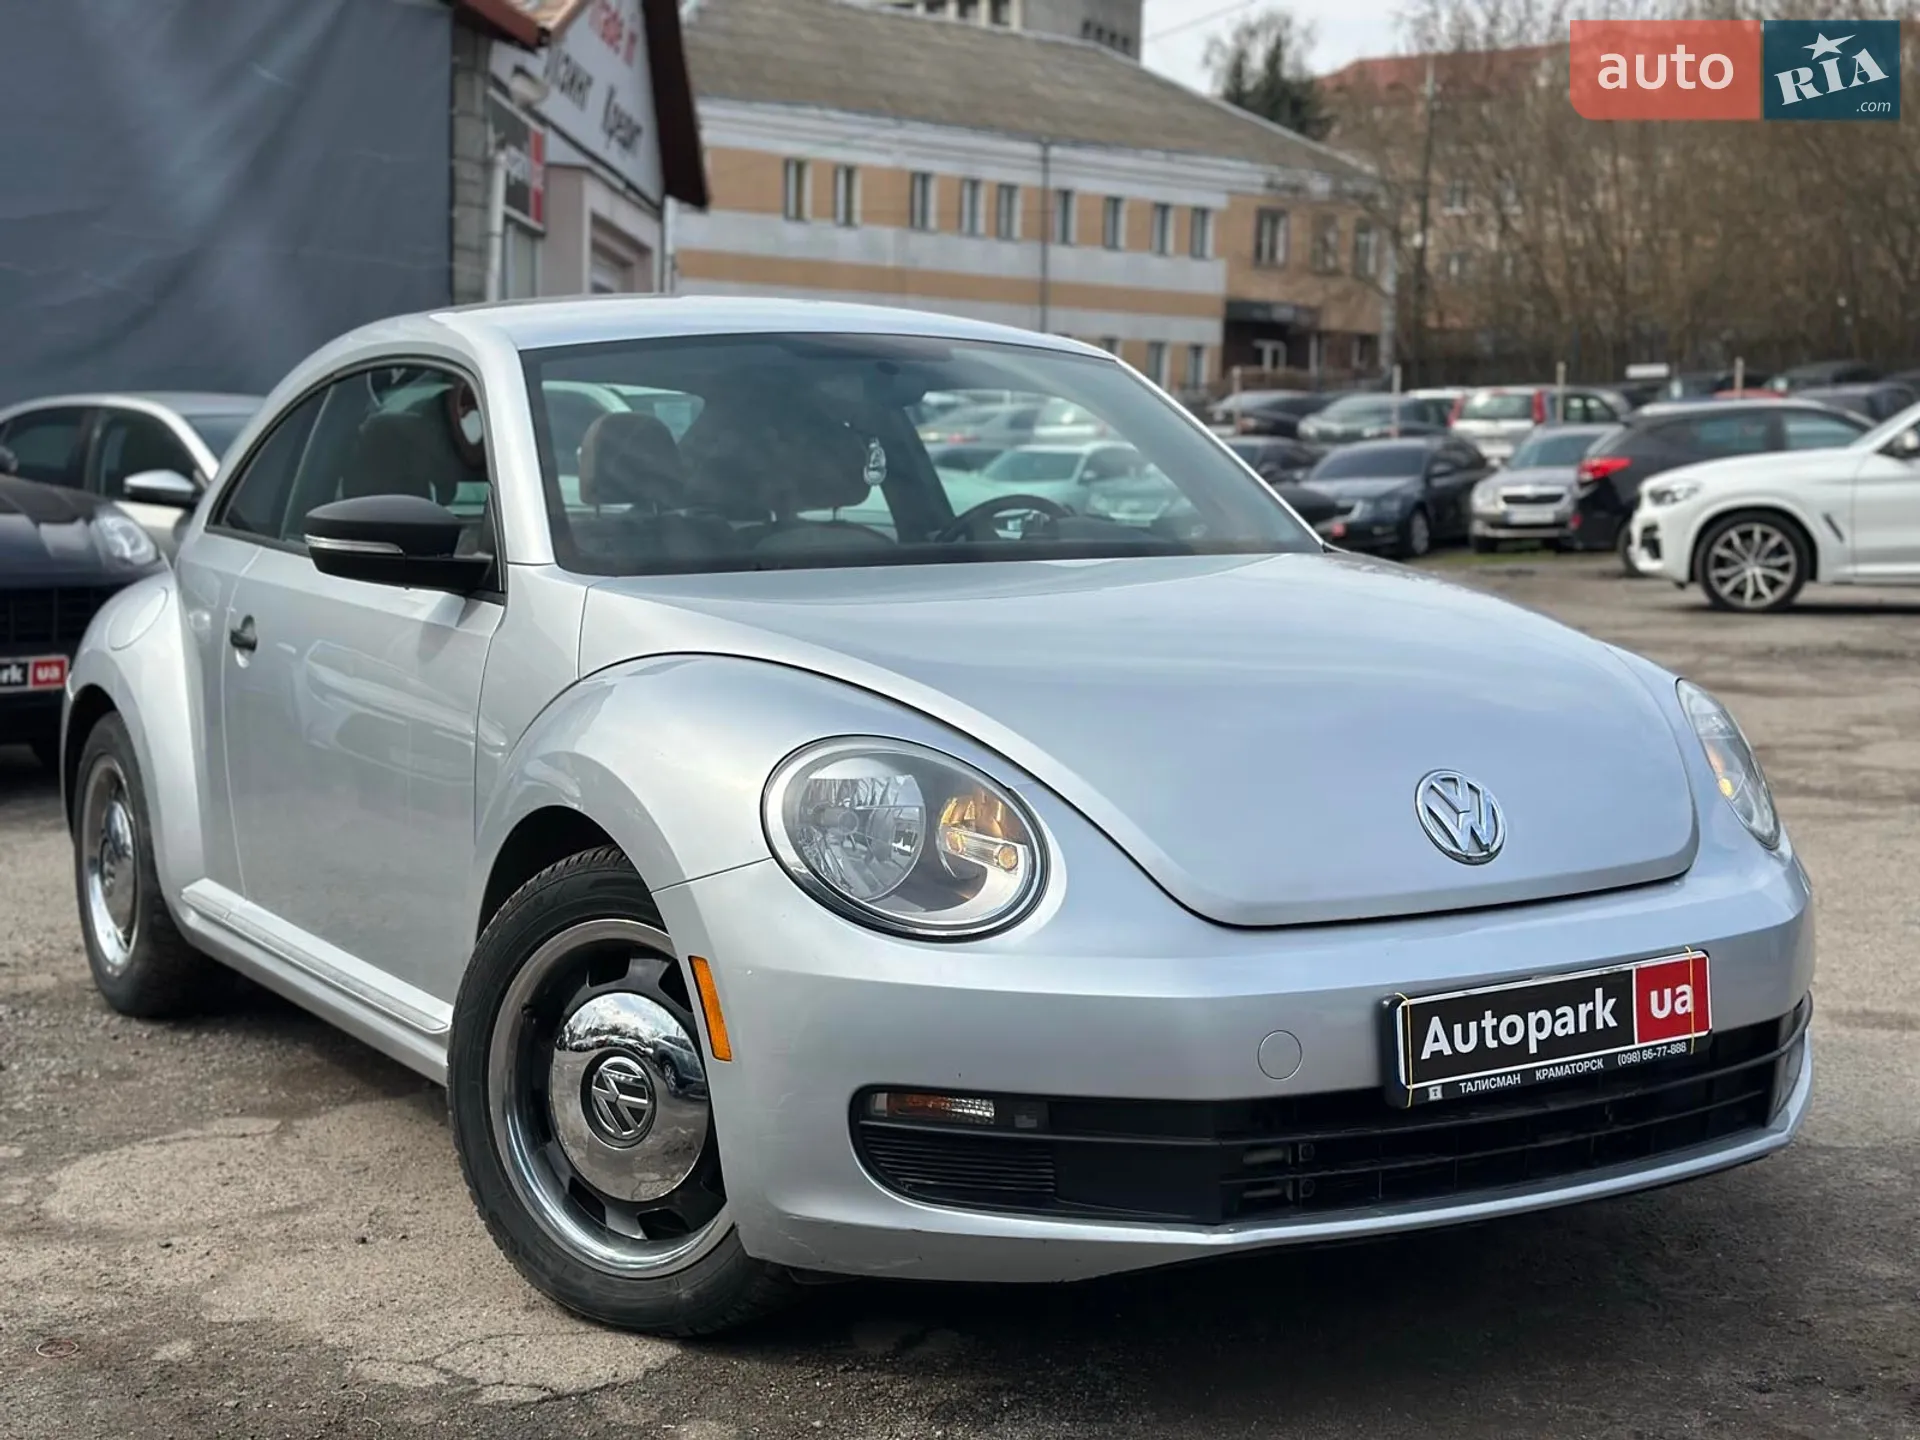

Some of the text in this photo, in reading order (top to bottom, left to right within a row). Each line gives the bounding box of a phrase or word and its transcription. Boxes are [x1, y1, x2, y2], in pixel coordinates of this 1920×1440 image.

[35, 664, 62, 683] ua
[1420, 983, 1693, 1060] Autopark ua
[1459, 1073, 1521, 1095] ТАЛИСМАН
[1535, 1058, 1604, 1081] КРАМАТОРСК
[1617, 1050, 1641, 1066] (098)
